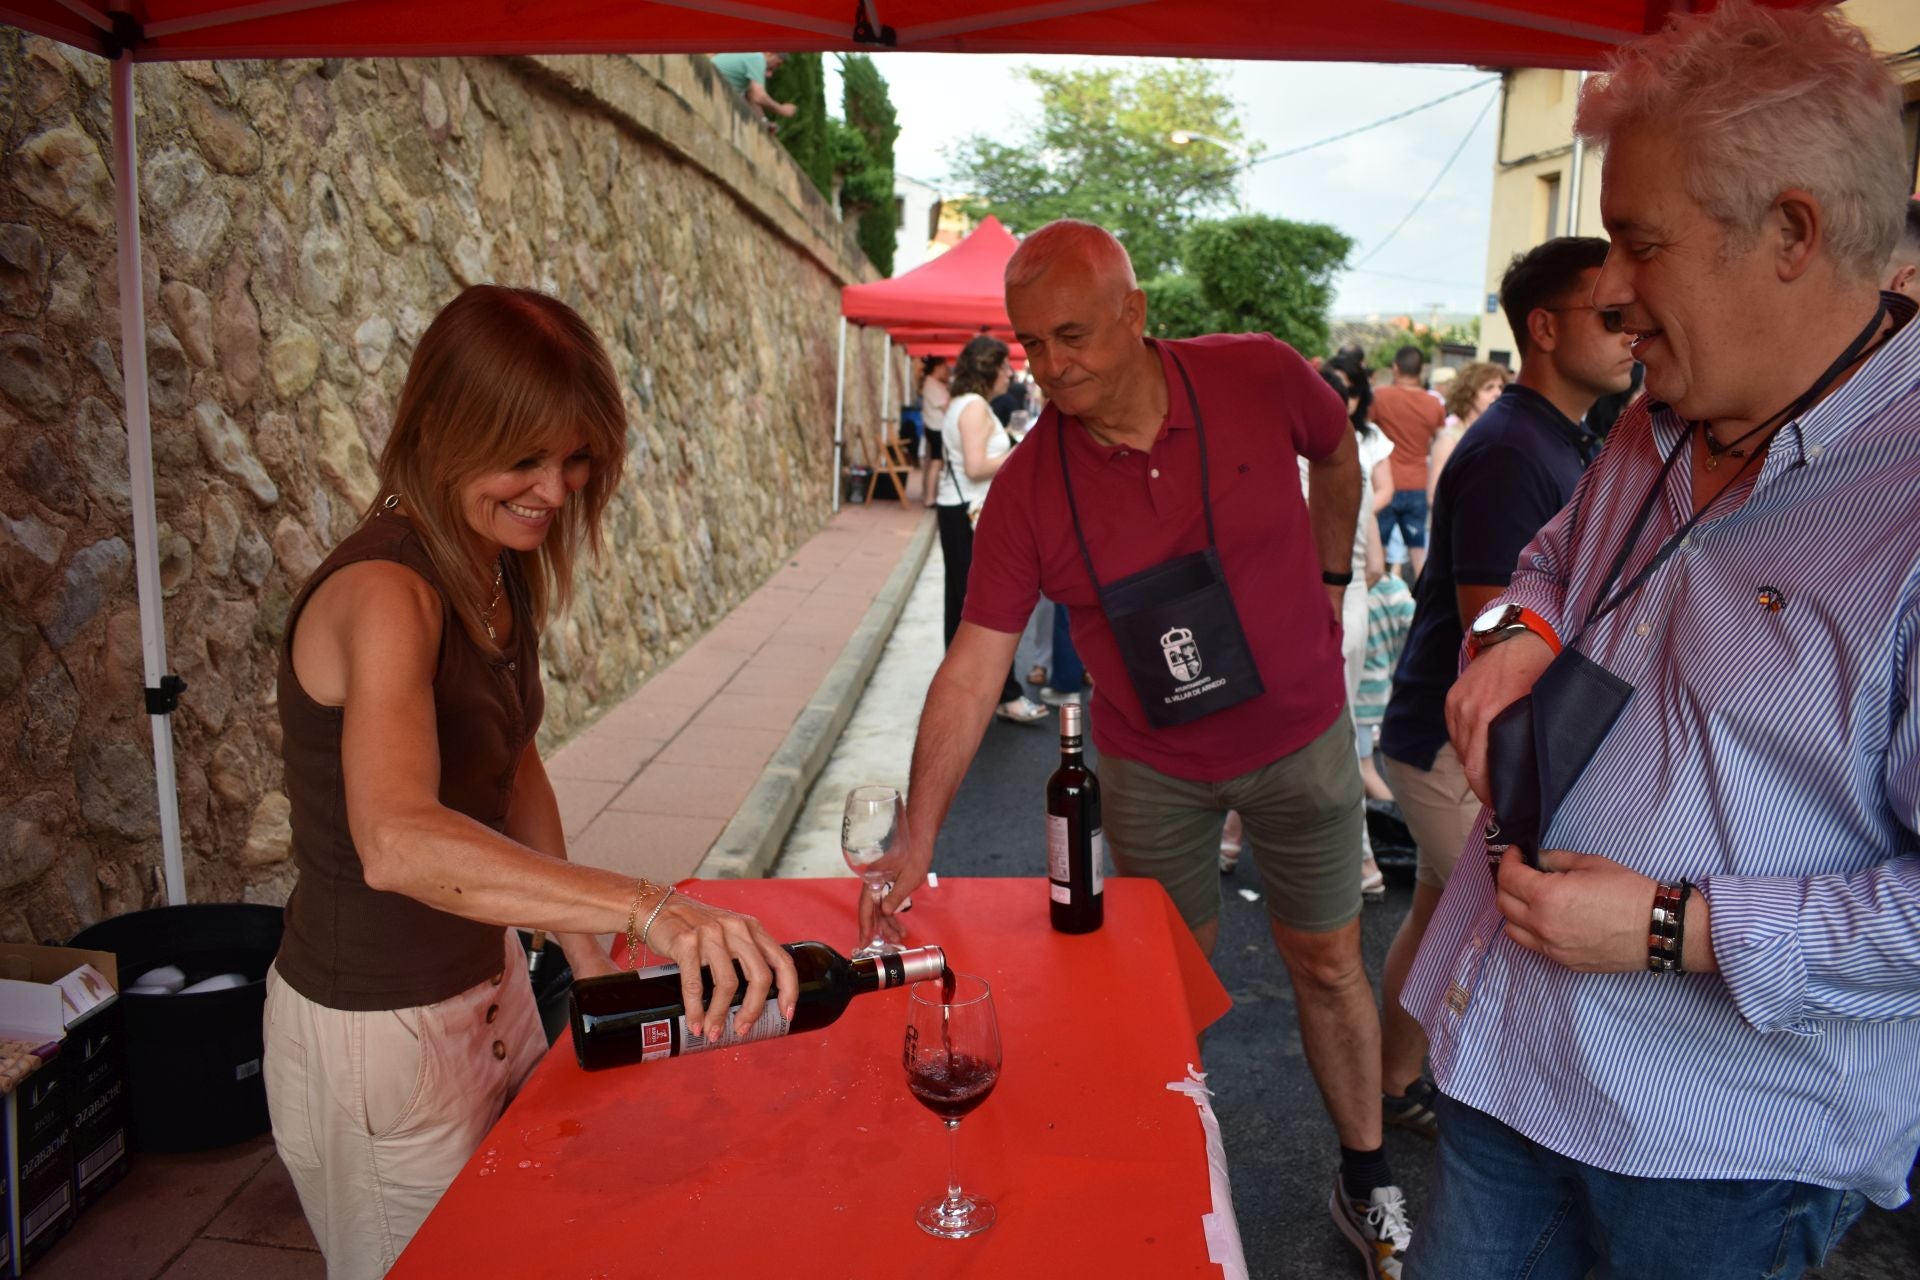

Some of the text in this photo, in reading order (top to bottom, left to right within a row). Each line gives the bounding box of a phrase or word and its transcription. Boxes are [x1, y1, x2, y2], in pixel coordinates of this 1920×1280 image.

[1171, 691, 1192, 702] VILLAR
[1192, 688, 1201, 696] DE
[1202, 678, 1226, 692] ARNEDO
